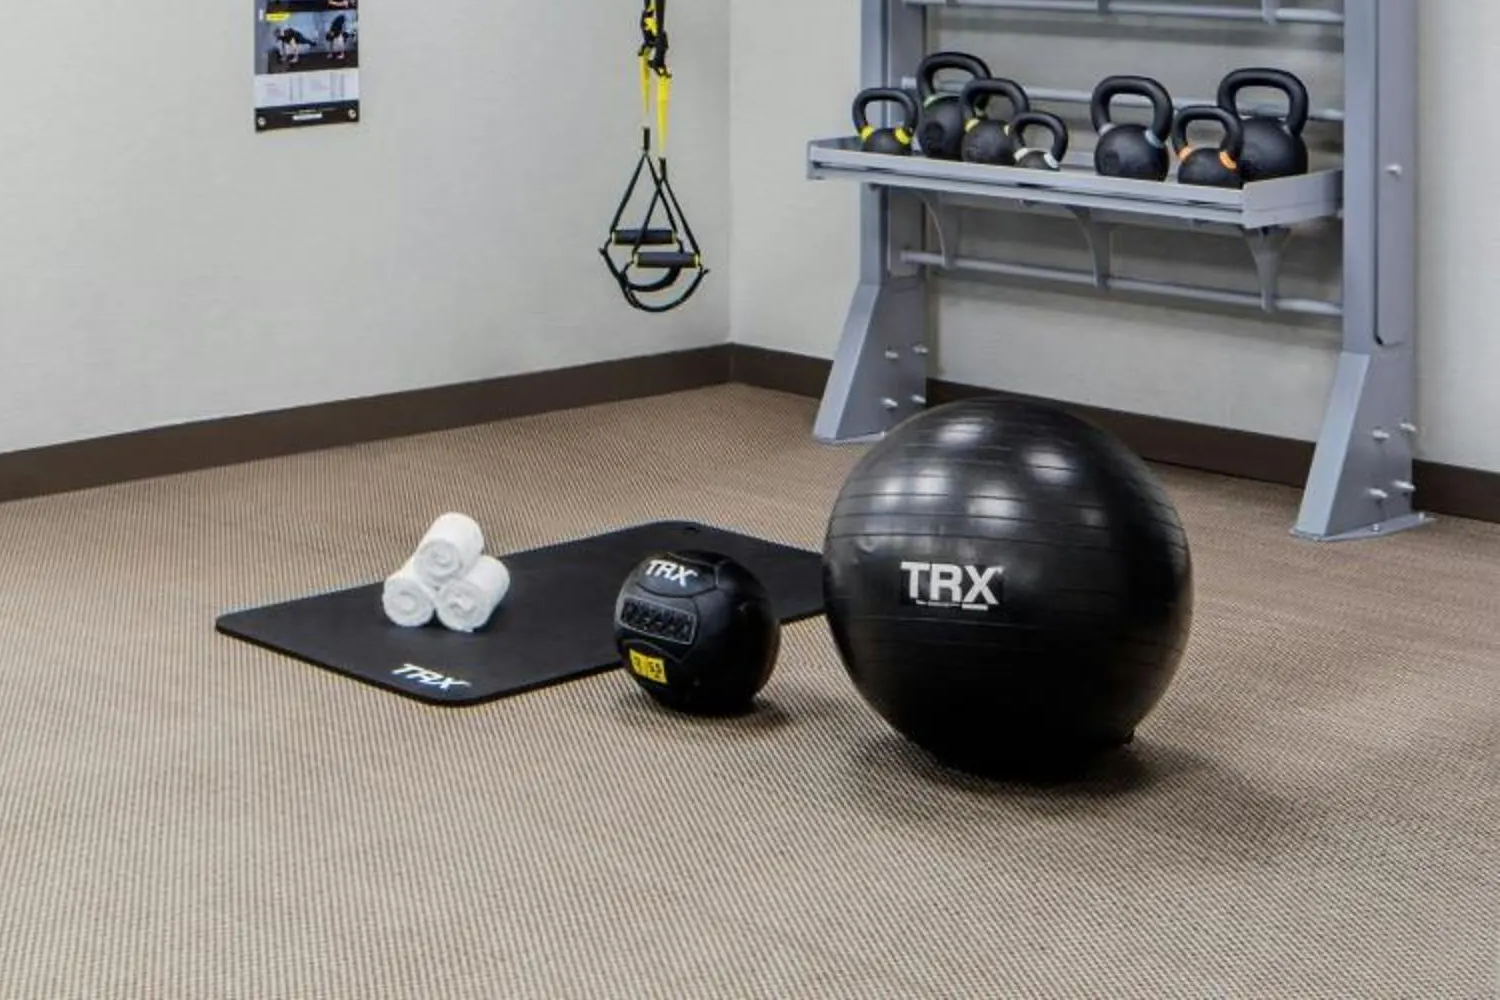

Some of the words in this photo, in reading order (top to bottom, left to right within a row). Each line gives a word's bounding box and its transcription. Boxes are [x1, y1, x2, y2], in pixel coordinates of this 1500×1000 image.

[645, 559, 698, 587] TRX
[901, 561, 1005, 605] TRX
[392, 663, 472, 690] TRX
